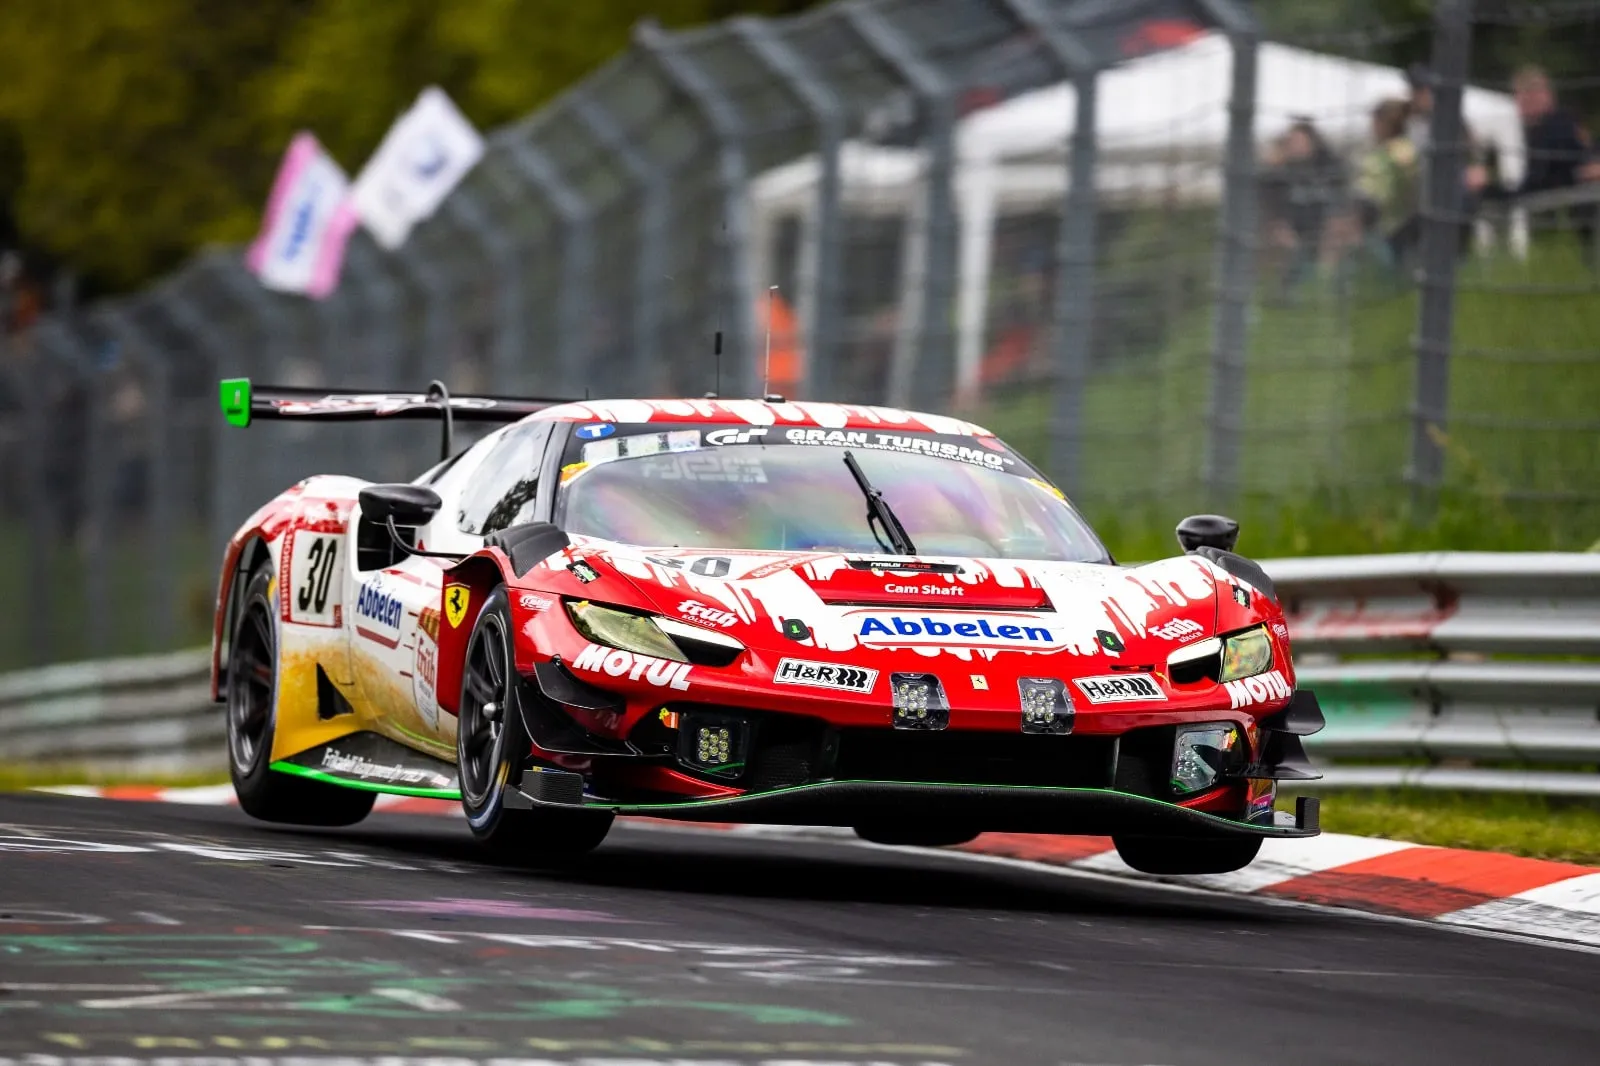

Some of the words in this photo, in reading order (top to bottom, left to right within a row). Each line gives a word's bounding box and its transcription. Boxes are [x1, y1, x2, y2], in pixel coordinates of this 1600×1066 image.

[785, 428, 867, 444] GRAN
[874, 433, 1003, 467] TURISMO
[863, 442, 923, 455] DRIVING
[924, 450, 1005, 471] SIMULATOR
[298, 537, 337, 614] 30
[884, 583, 919, 595] Cam
[921, 584, 965, 596] Shaft
[356, 583, 403, 630] Abbelen
[859, 616, 1054, 642] Abbelen
[571, 643, 695, 691] MOTUL
[780, 662, 834, 683] H&R
[1084, 679, 1130, 698] H&R
[1223, 669, 1292, 709] MOTUL
